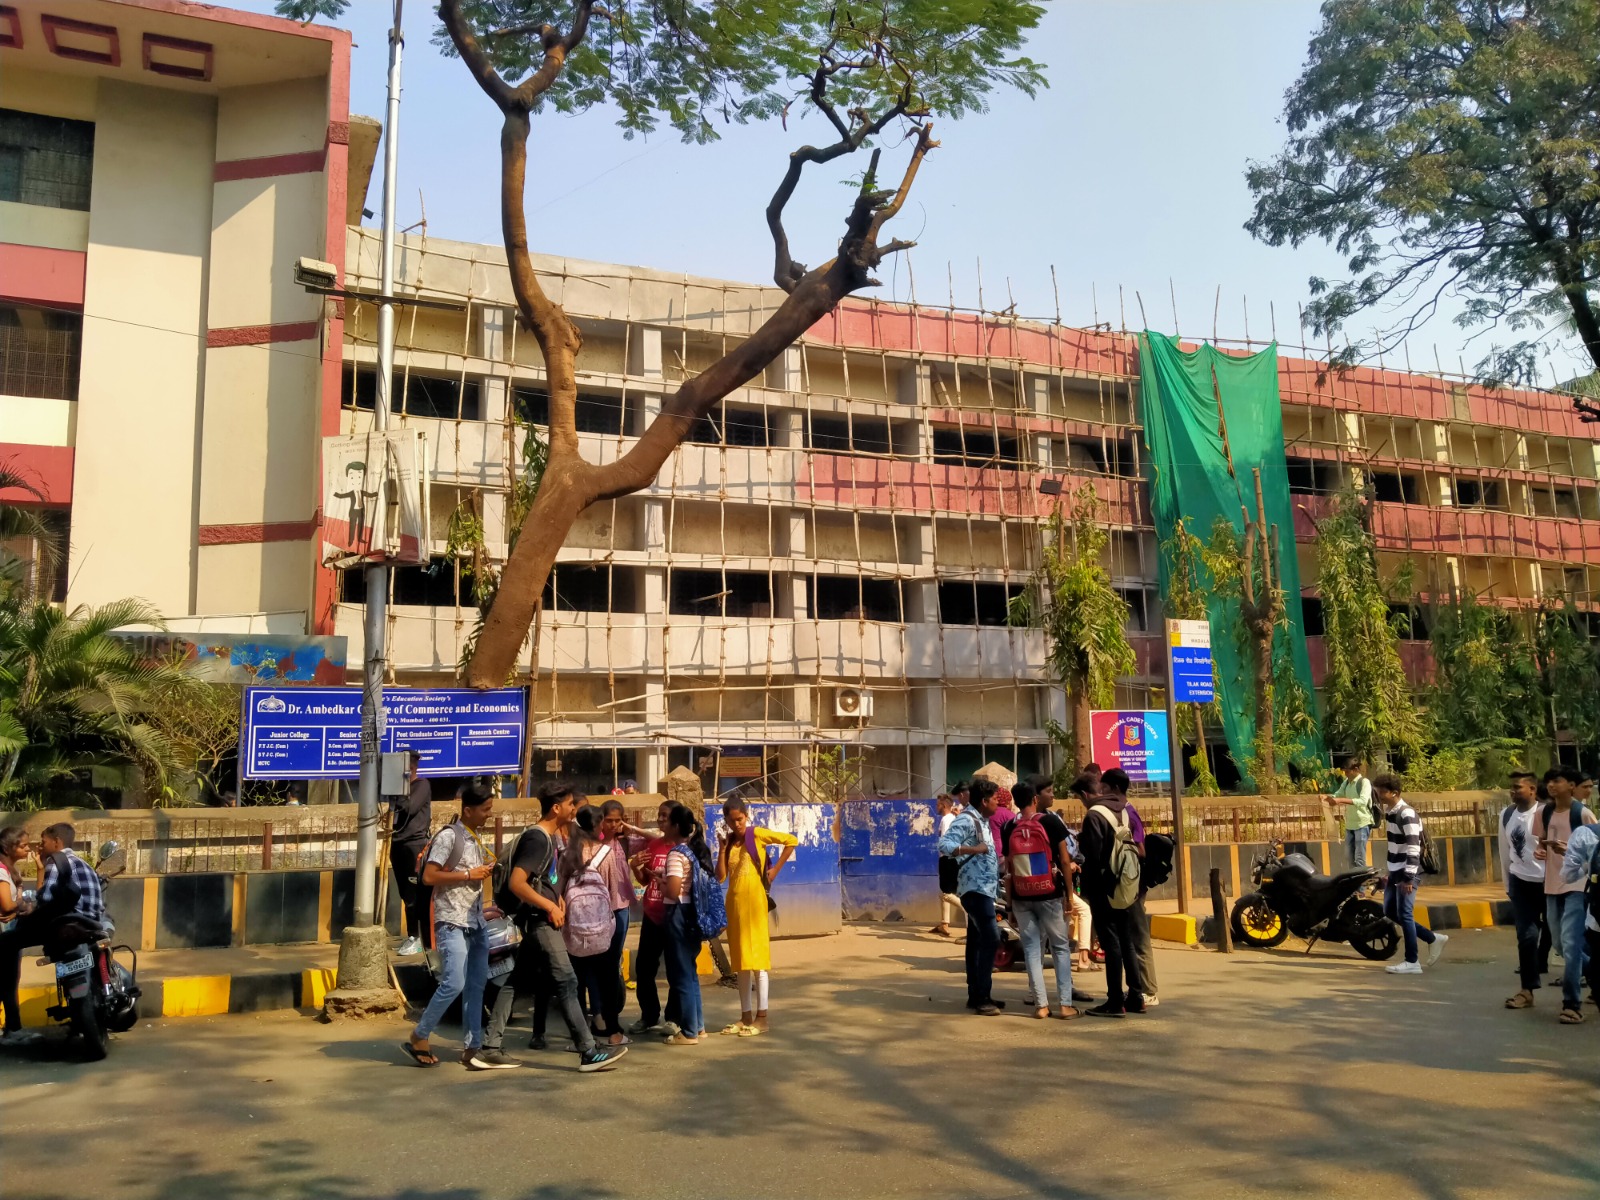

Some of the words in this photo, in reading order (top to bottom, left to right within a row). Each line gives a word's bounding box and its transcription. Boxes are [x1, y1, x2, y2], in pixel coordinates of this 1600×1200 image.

[424, 695, 451, 703] Society's
[288, 704, 302, 714] Dr.
[304, 704, 355, 714] Ambedkar
[394, 704, 404, 714] of
[405, 704, 453, 714] Commerce
[455, 704, 471, 714] and
[473, 703, 520, 713] Economics
[1106, 718, 1126, 740] NATIONAL
[1144, 722, 1158, 740] CORPS
[1016, 880, 1052, 890] HILFIGER
